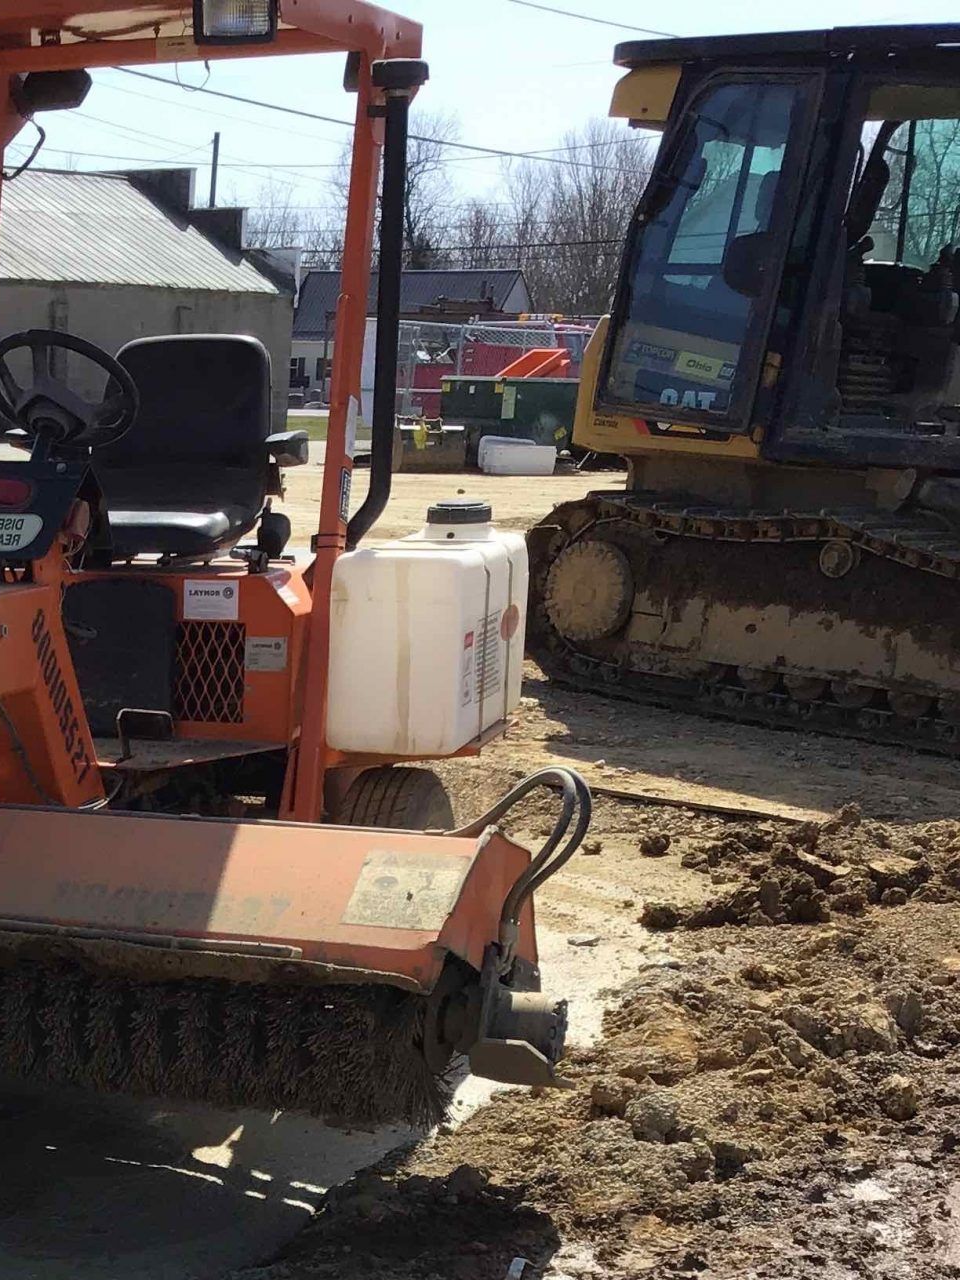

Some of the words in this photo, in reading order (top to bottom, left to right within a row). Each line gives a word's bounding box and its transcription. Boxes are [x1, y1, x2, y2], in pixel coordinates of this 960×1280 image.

[685, 359, 713, 373] Ohio
[660, 388, 716, 410] CAT
[189, 589, 221, 597] LAYMOR
